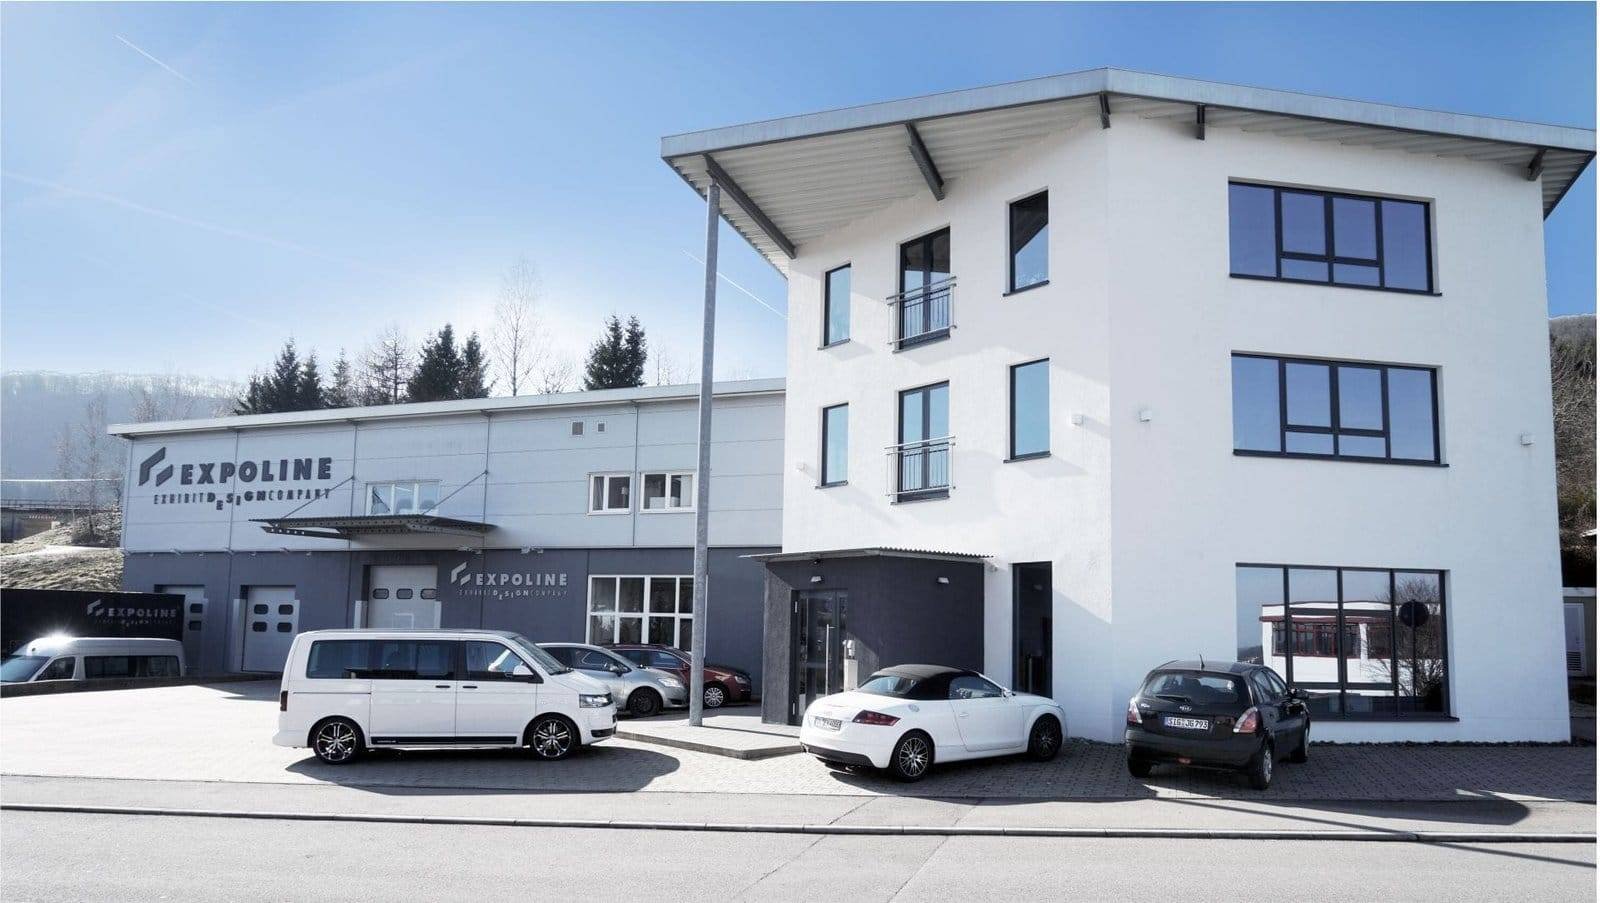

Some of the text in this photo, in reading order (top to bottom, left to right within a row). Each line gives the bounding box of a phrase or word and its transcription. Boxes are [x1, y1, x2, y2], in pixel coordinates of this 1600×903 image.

[180, 457, 332, 485] EXPOLINE
[475, 573, 567, 586] EXPOLINE
[108, 607, 177, 618] EXPOLINE
